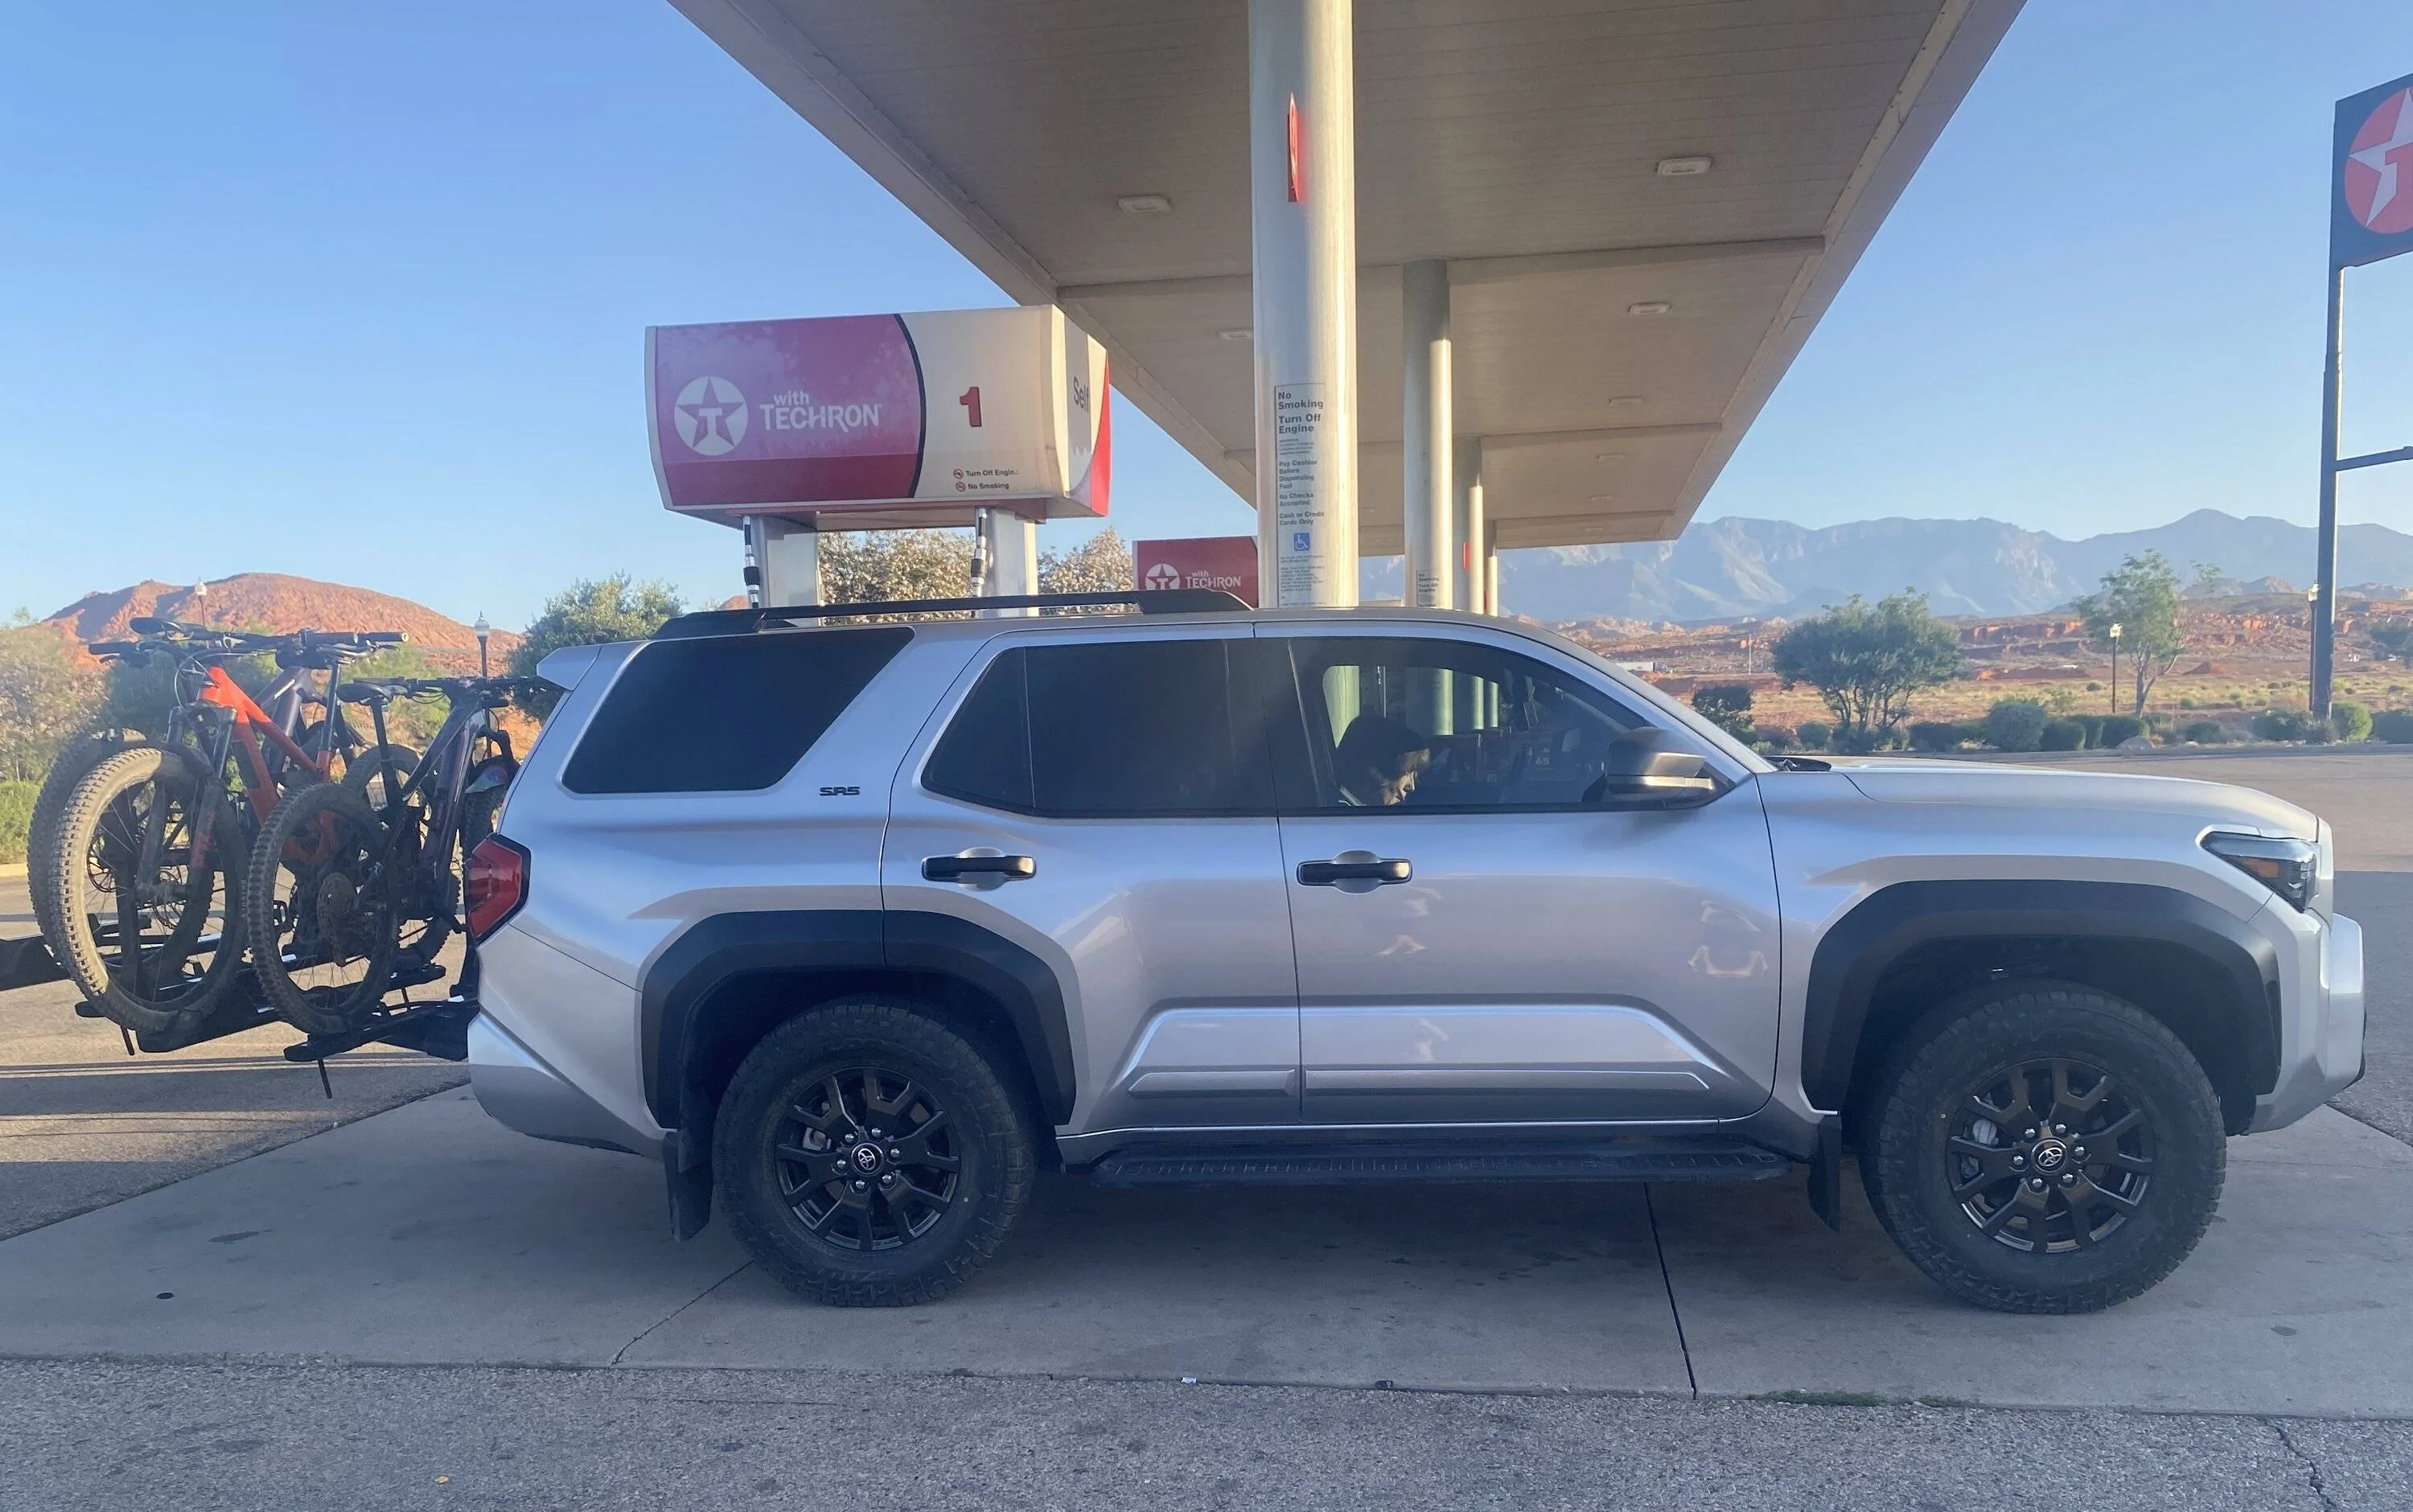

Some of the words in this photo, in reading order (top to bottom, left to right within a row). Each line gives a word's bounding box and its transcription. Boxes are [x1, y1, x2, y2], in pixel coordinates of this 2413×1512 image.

[773, 390, 810, 405] with
[1278, 392, 1292, 400] No
[960, 386, 982, 427] 1
[1278, 400, 1323, 410] Smoking
[759, 404, 879, 433] TECHRON
[1279, 415, 1302, 424] Turn
[1305, 413, 1321, 422] Off
[1279, 425, 1314, 434] Engine
[1279, 475, 1314, 483] Dispensing
[1191, 569, 1209, 577] with
[1185, 576, 1241, 590] TECHRON
[820, 787, 861, 796] SR5
